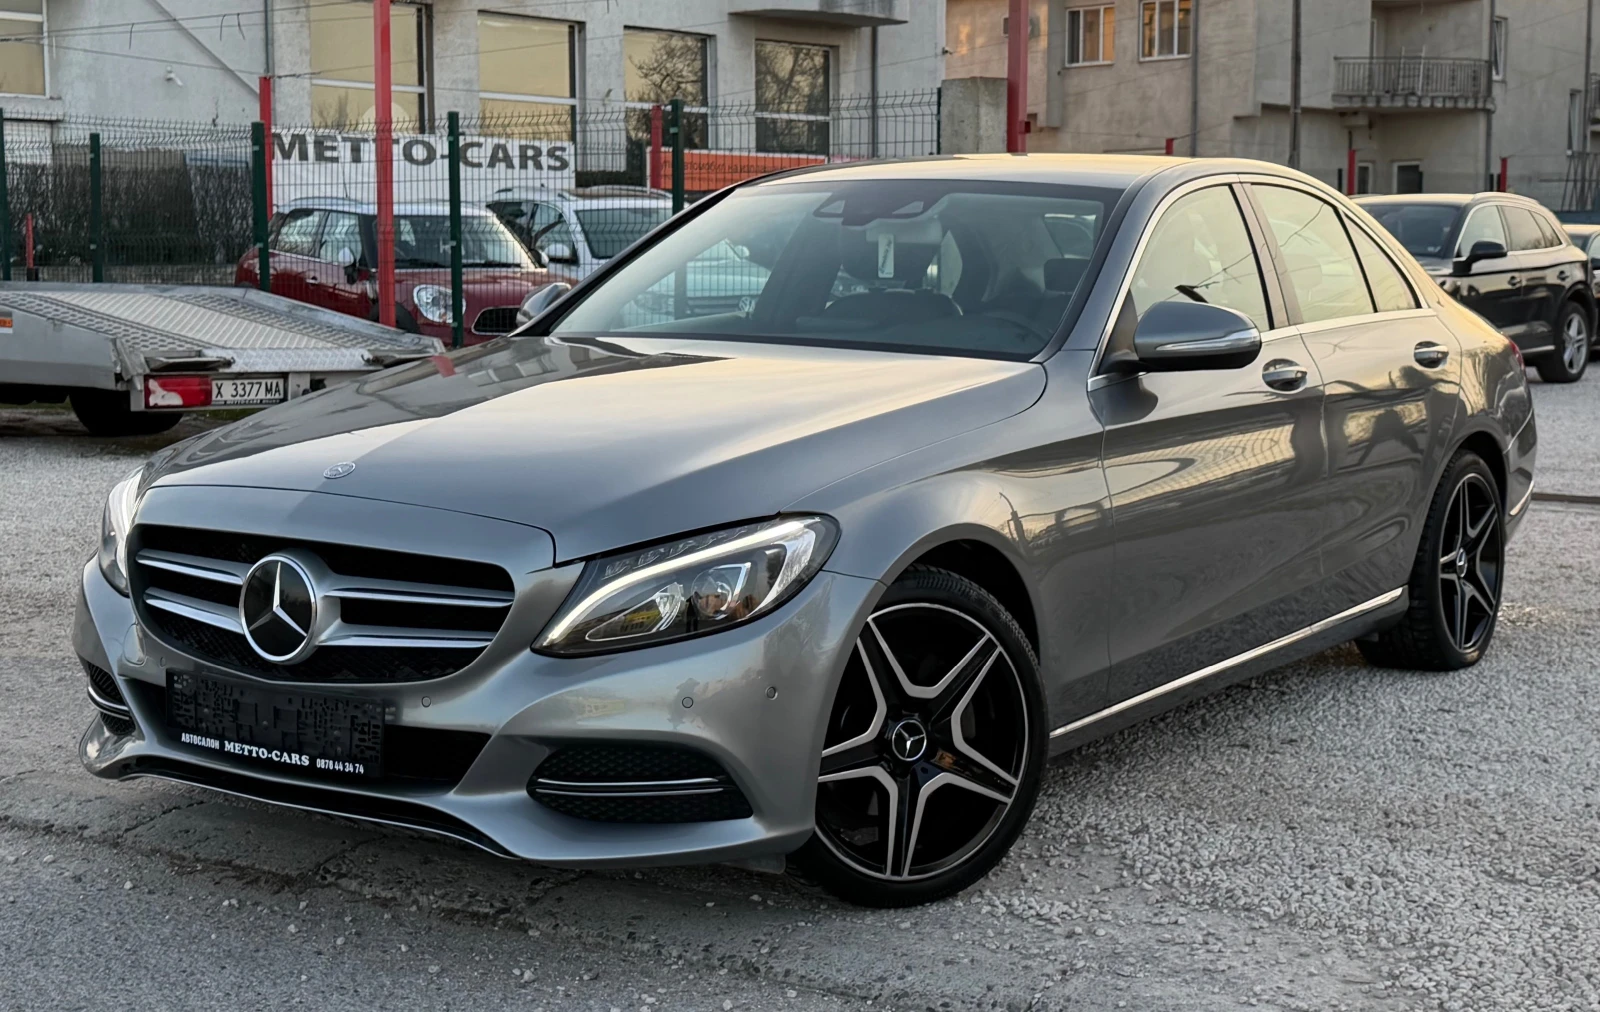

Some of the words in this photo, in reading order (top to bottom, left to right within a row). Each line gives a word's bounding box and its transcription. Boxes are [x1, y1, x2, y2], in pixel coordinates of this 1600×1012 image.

[215, 382, 223, 399] X
[231, 381, 262, 398] 3377
[264, 381, 281, 398] MA
[181, 732, 220, 749] АВТОСАЛОН
[224, 740, 310, 766] METTO-CARS
[354, 763, 364, 775] 74
